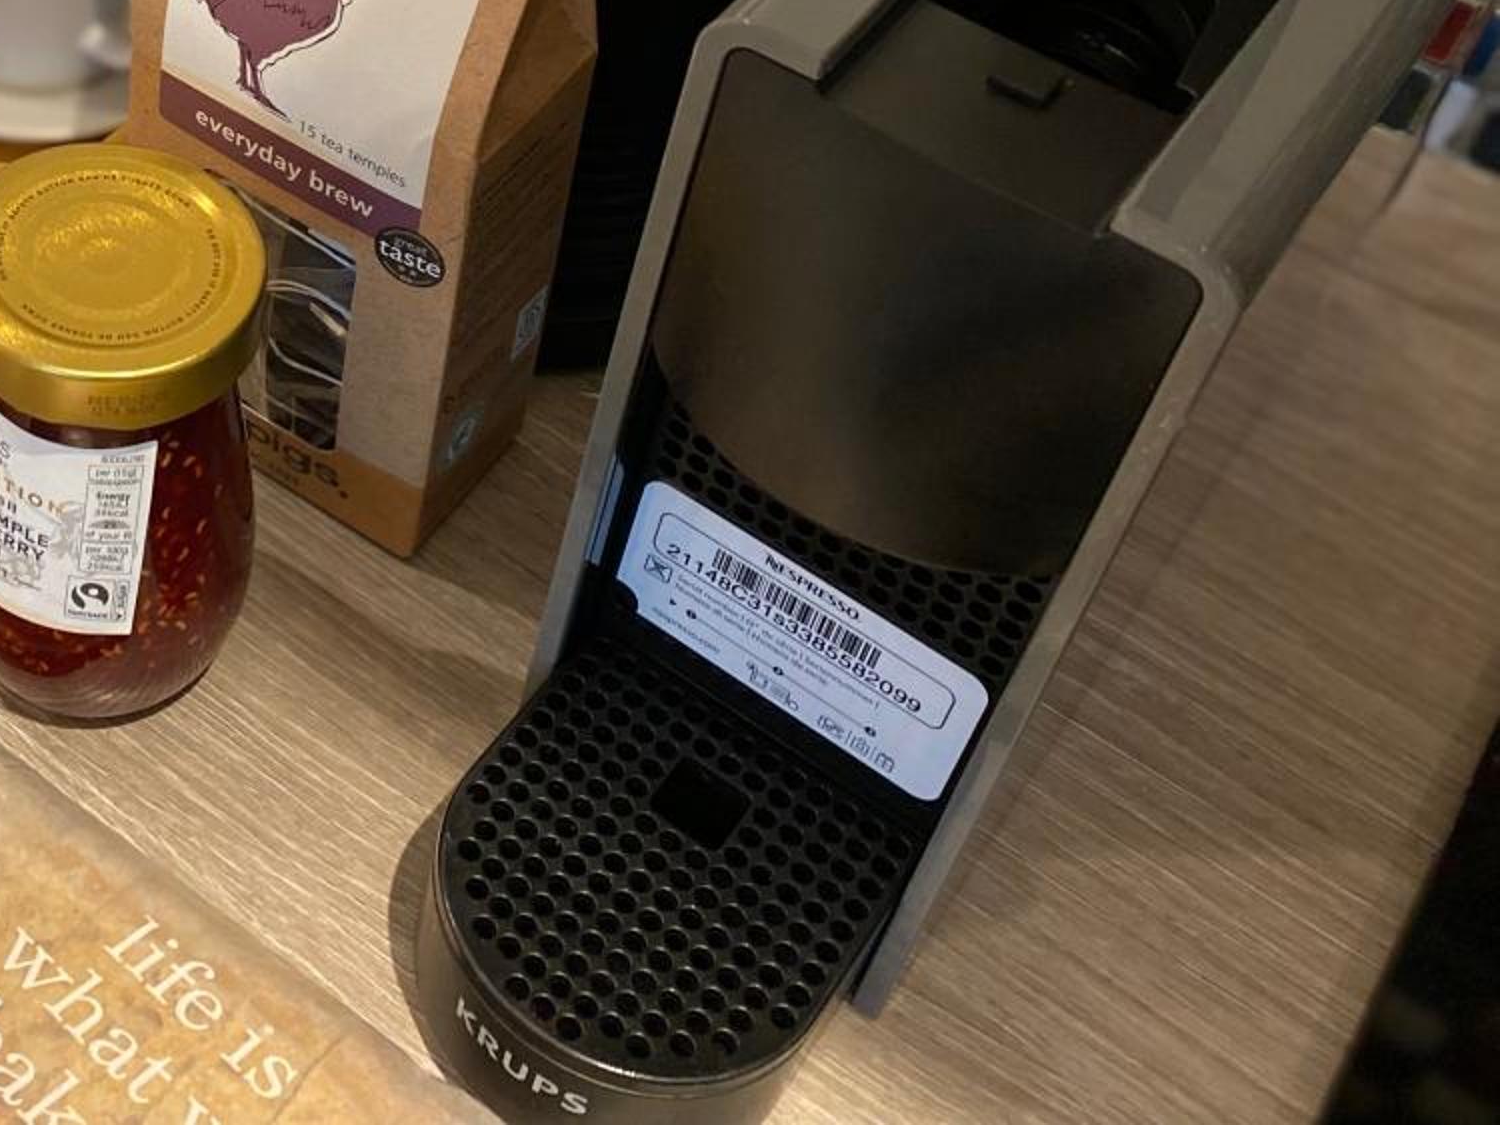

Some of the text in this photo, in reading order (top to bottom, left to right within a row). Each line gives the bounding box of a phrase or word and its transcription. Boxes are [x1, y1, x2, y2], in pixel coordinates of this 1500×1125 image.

[195, 109, 373, 218] everyday brew
[299, 120, 406, 189] 15 tea temples
[380, 240, 441, 279] taste
[765, 554, 861, 621] NESPRESSO
[3, 926, 173, 1105] what
[103, 914, 298, 1100] life is
[455, 994, 589, 1116] KRUPS
